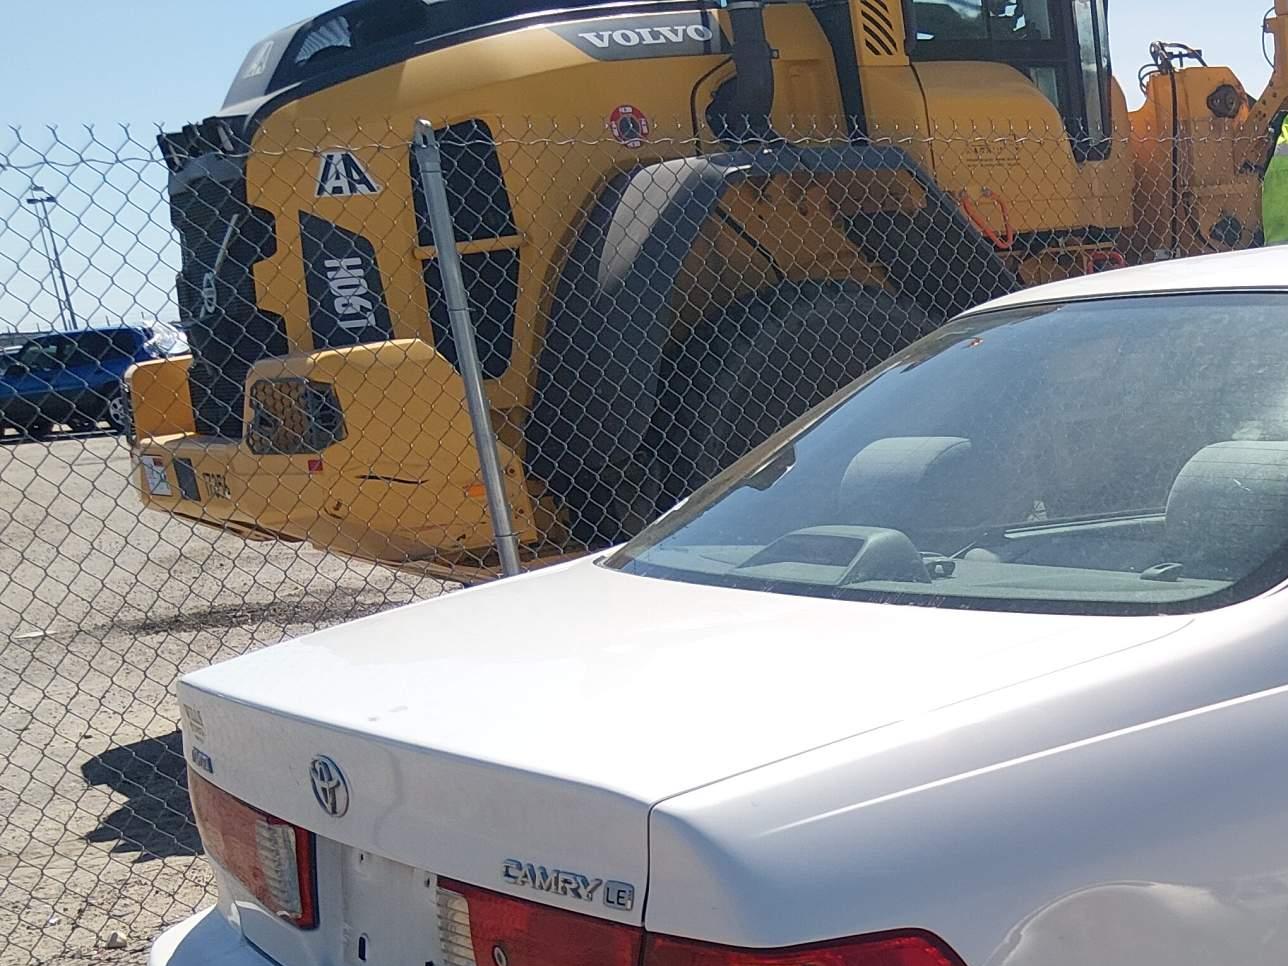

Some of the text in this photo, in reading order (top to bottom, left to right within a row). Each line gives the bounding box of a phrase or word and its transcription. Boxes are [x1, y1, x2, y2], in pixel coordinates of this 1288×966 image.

[578, 24, 713, 48] VOLVO
[502, 858, 627, 907] CAMRY LE
